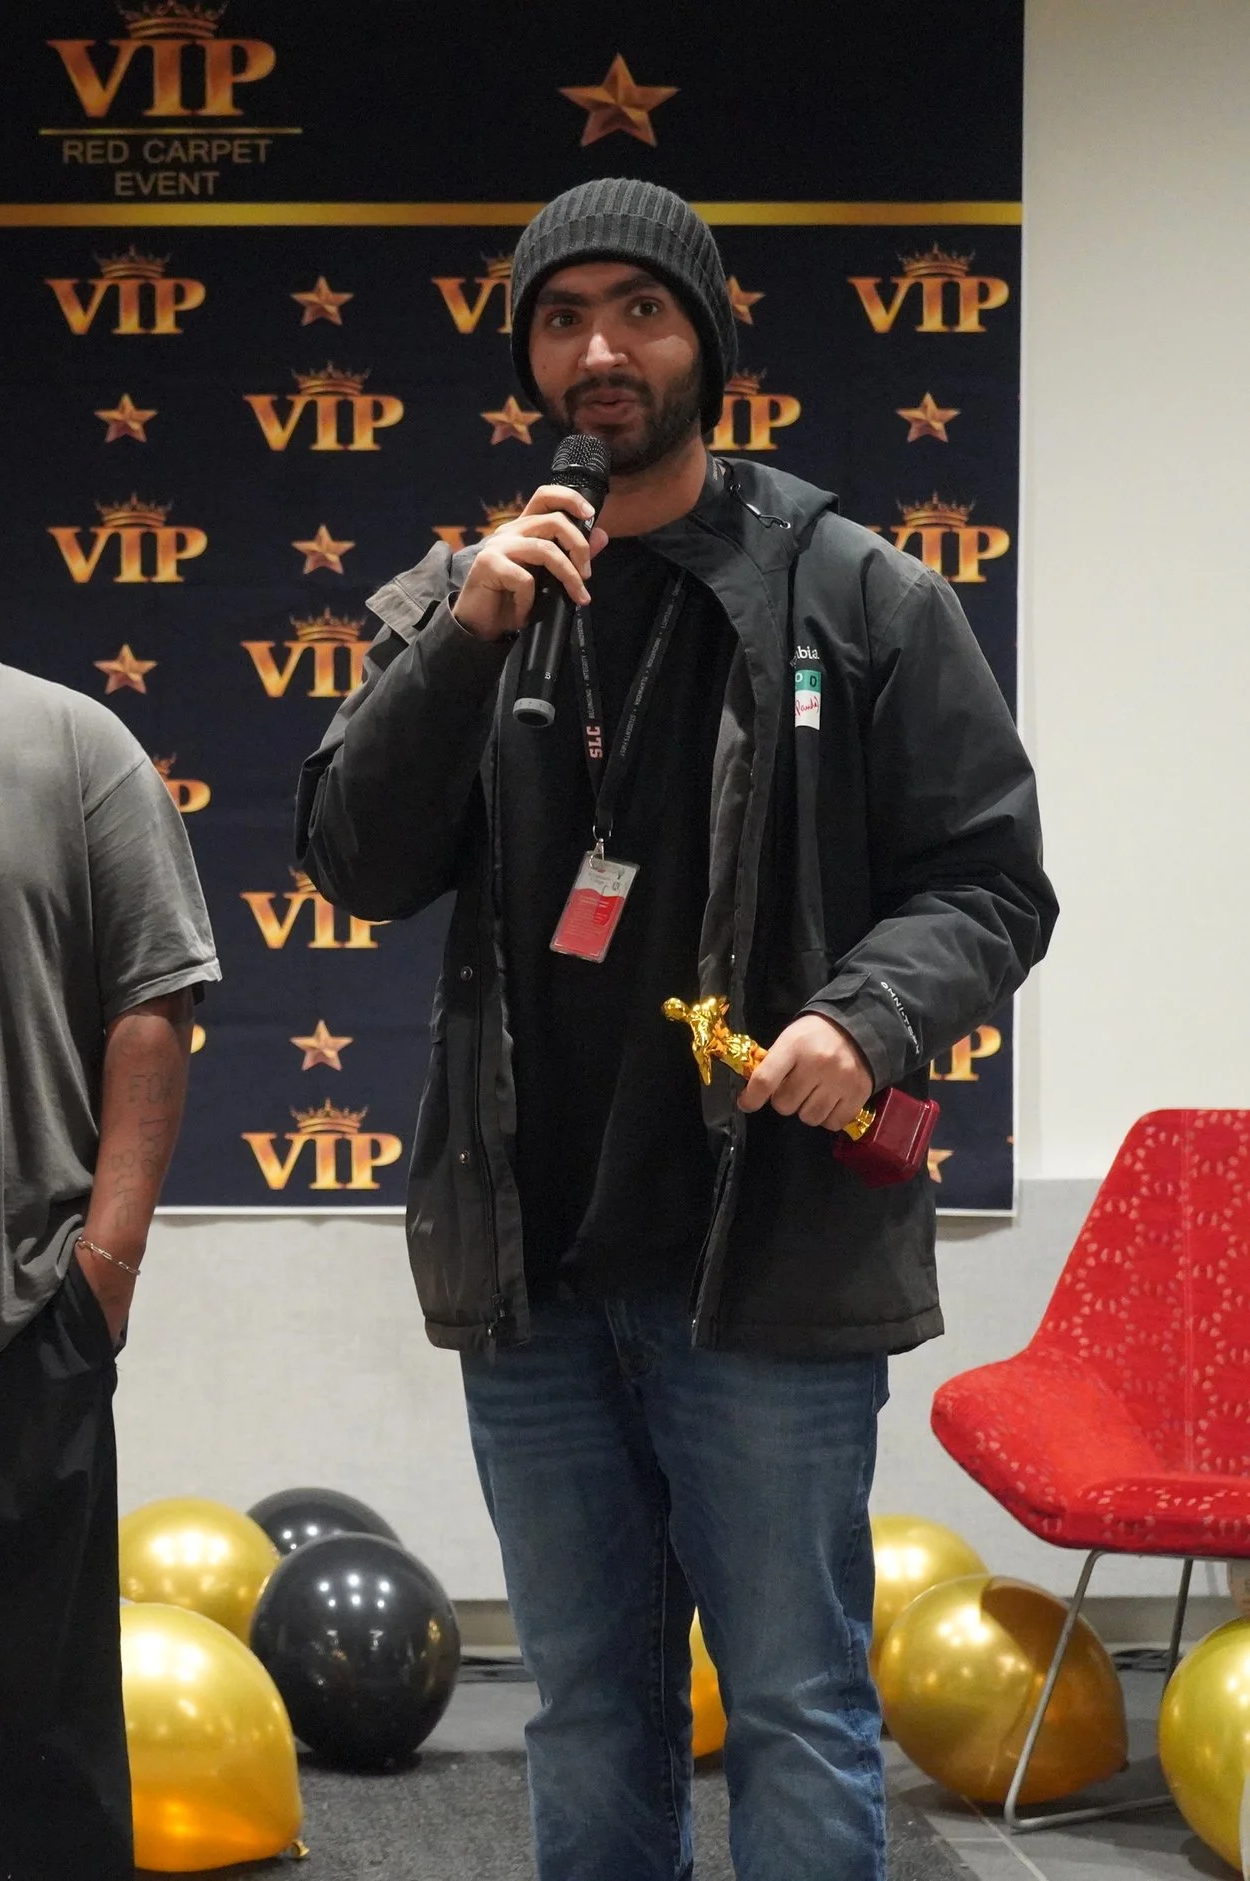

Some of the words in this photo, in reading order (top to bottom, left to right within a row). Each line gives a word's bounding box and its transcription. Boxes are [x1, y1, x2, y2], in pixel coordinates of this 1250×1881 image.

[47, 40, 276, 117] VIP
[63, 140, 129, 164] RED
[143, 140, 273, 164] CARPET
[114, 172, 220, 196] EVENT
[46, 278, 206, 335] VIP
[848, 277, 1010, 334] VIP
[244, 394, 405, 451] VIP
[708, 394, 802, 451] IP
[47, 527, 208, 584] VIP
[586, 726, 603, 759] SLC
[241, 1133, 403, 1190] VIP
